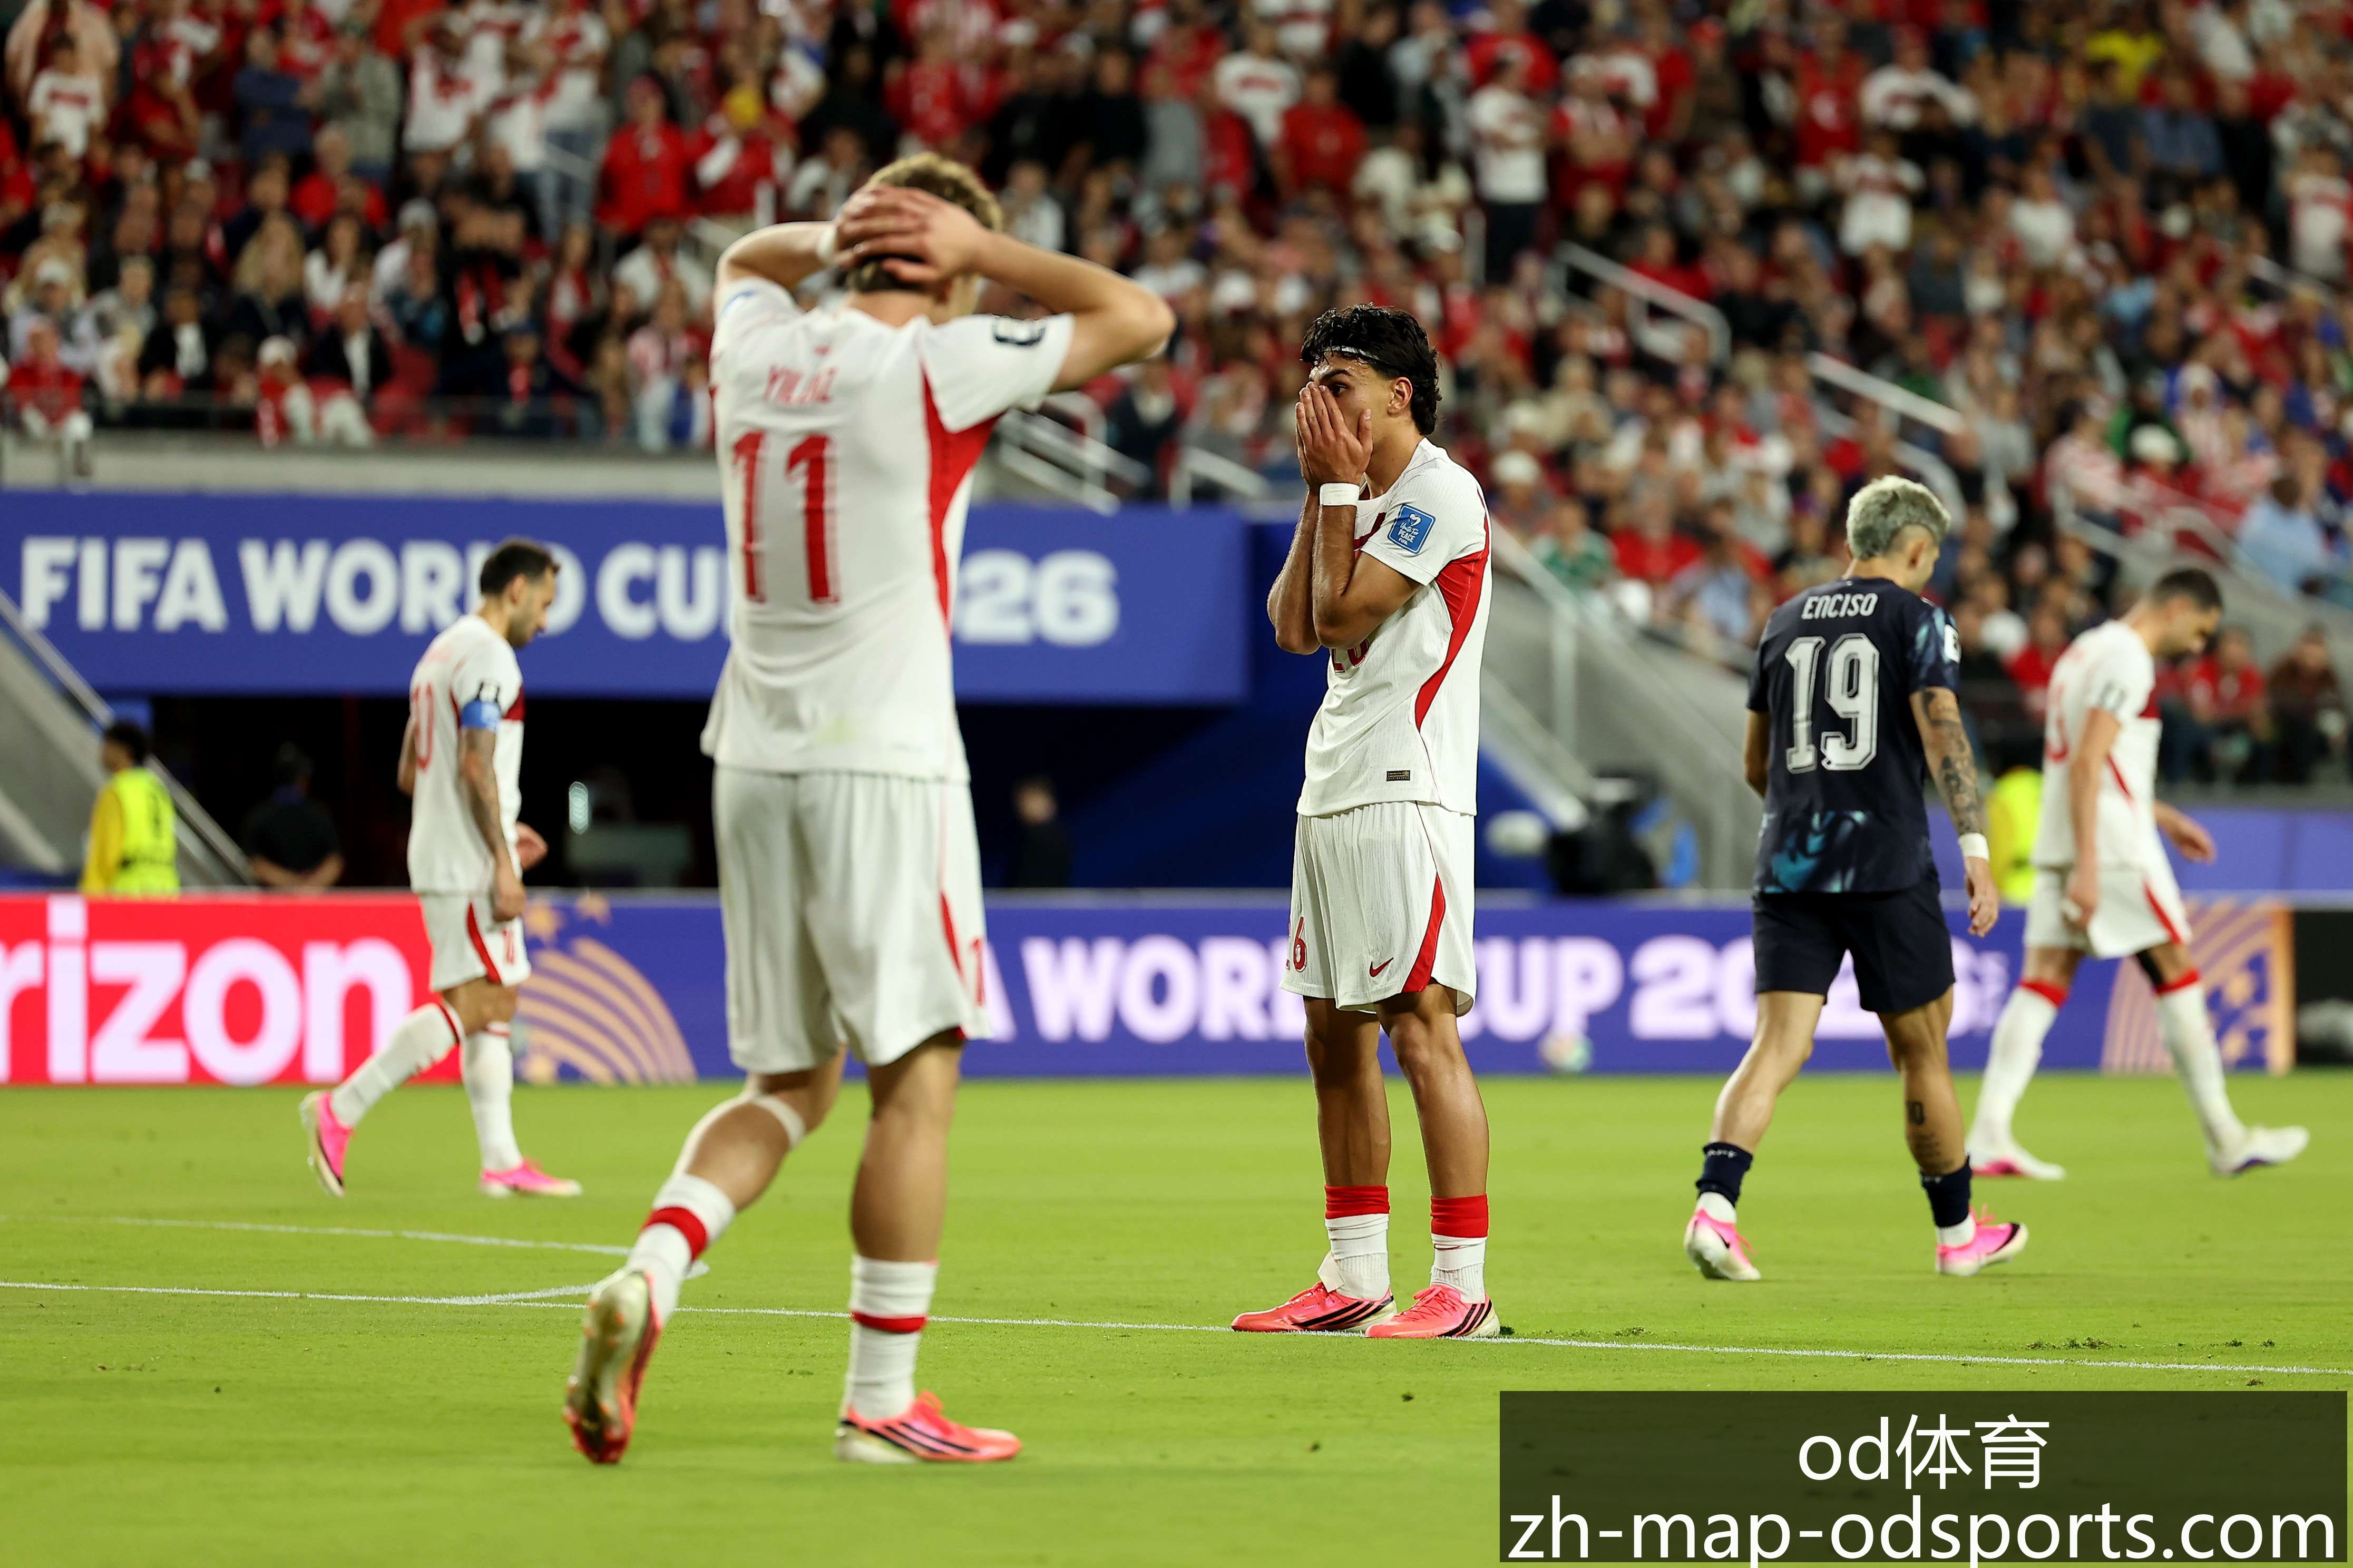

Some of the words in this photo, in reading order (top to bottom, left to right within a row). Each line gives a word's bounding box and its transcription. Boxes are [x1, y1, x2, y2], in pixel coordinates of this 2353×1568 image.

[731, 428, 840, 605] 11
[1398, 528, 1416, 543] PEACE
[22, 535, 229, 632] FIFA
[594, 541, 730, 642] CU
[953, 548, 1120, 646] 26
[1801, 592, 1879, 620] ENCISO
[1784, 632, 1880, 775] 19
[1286, 916, 1307, 973] 6
